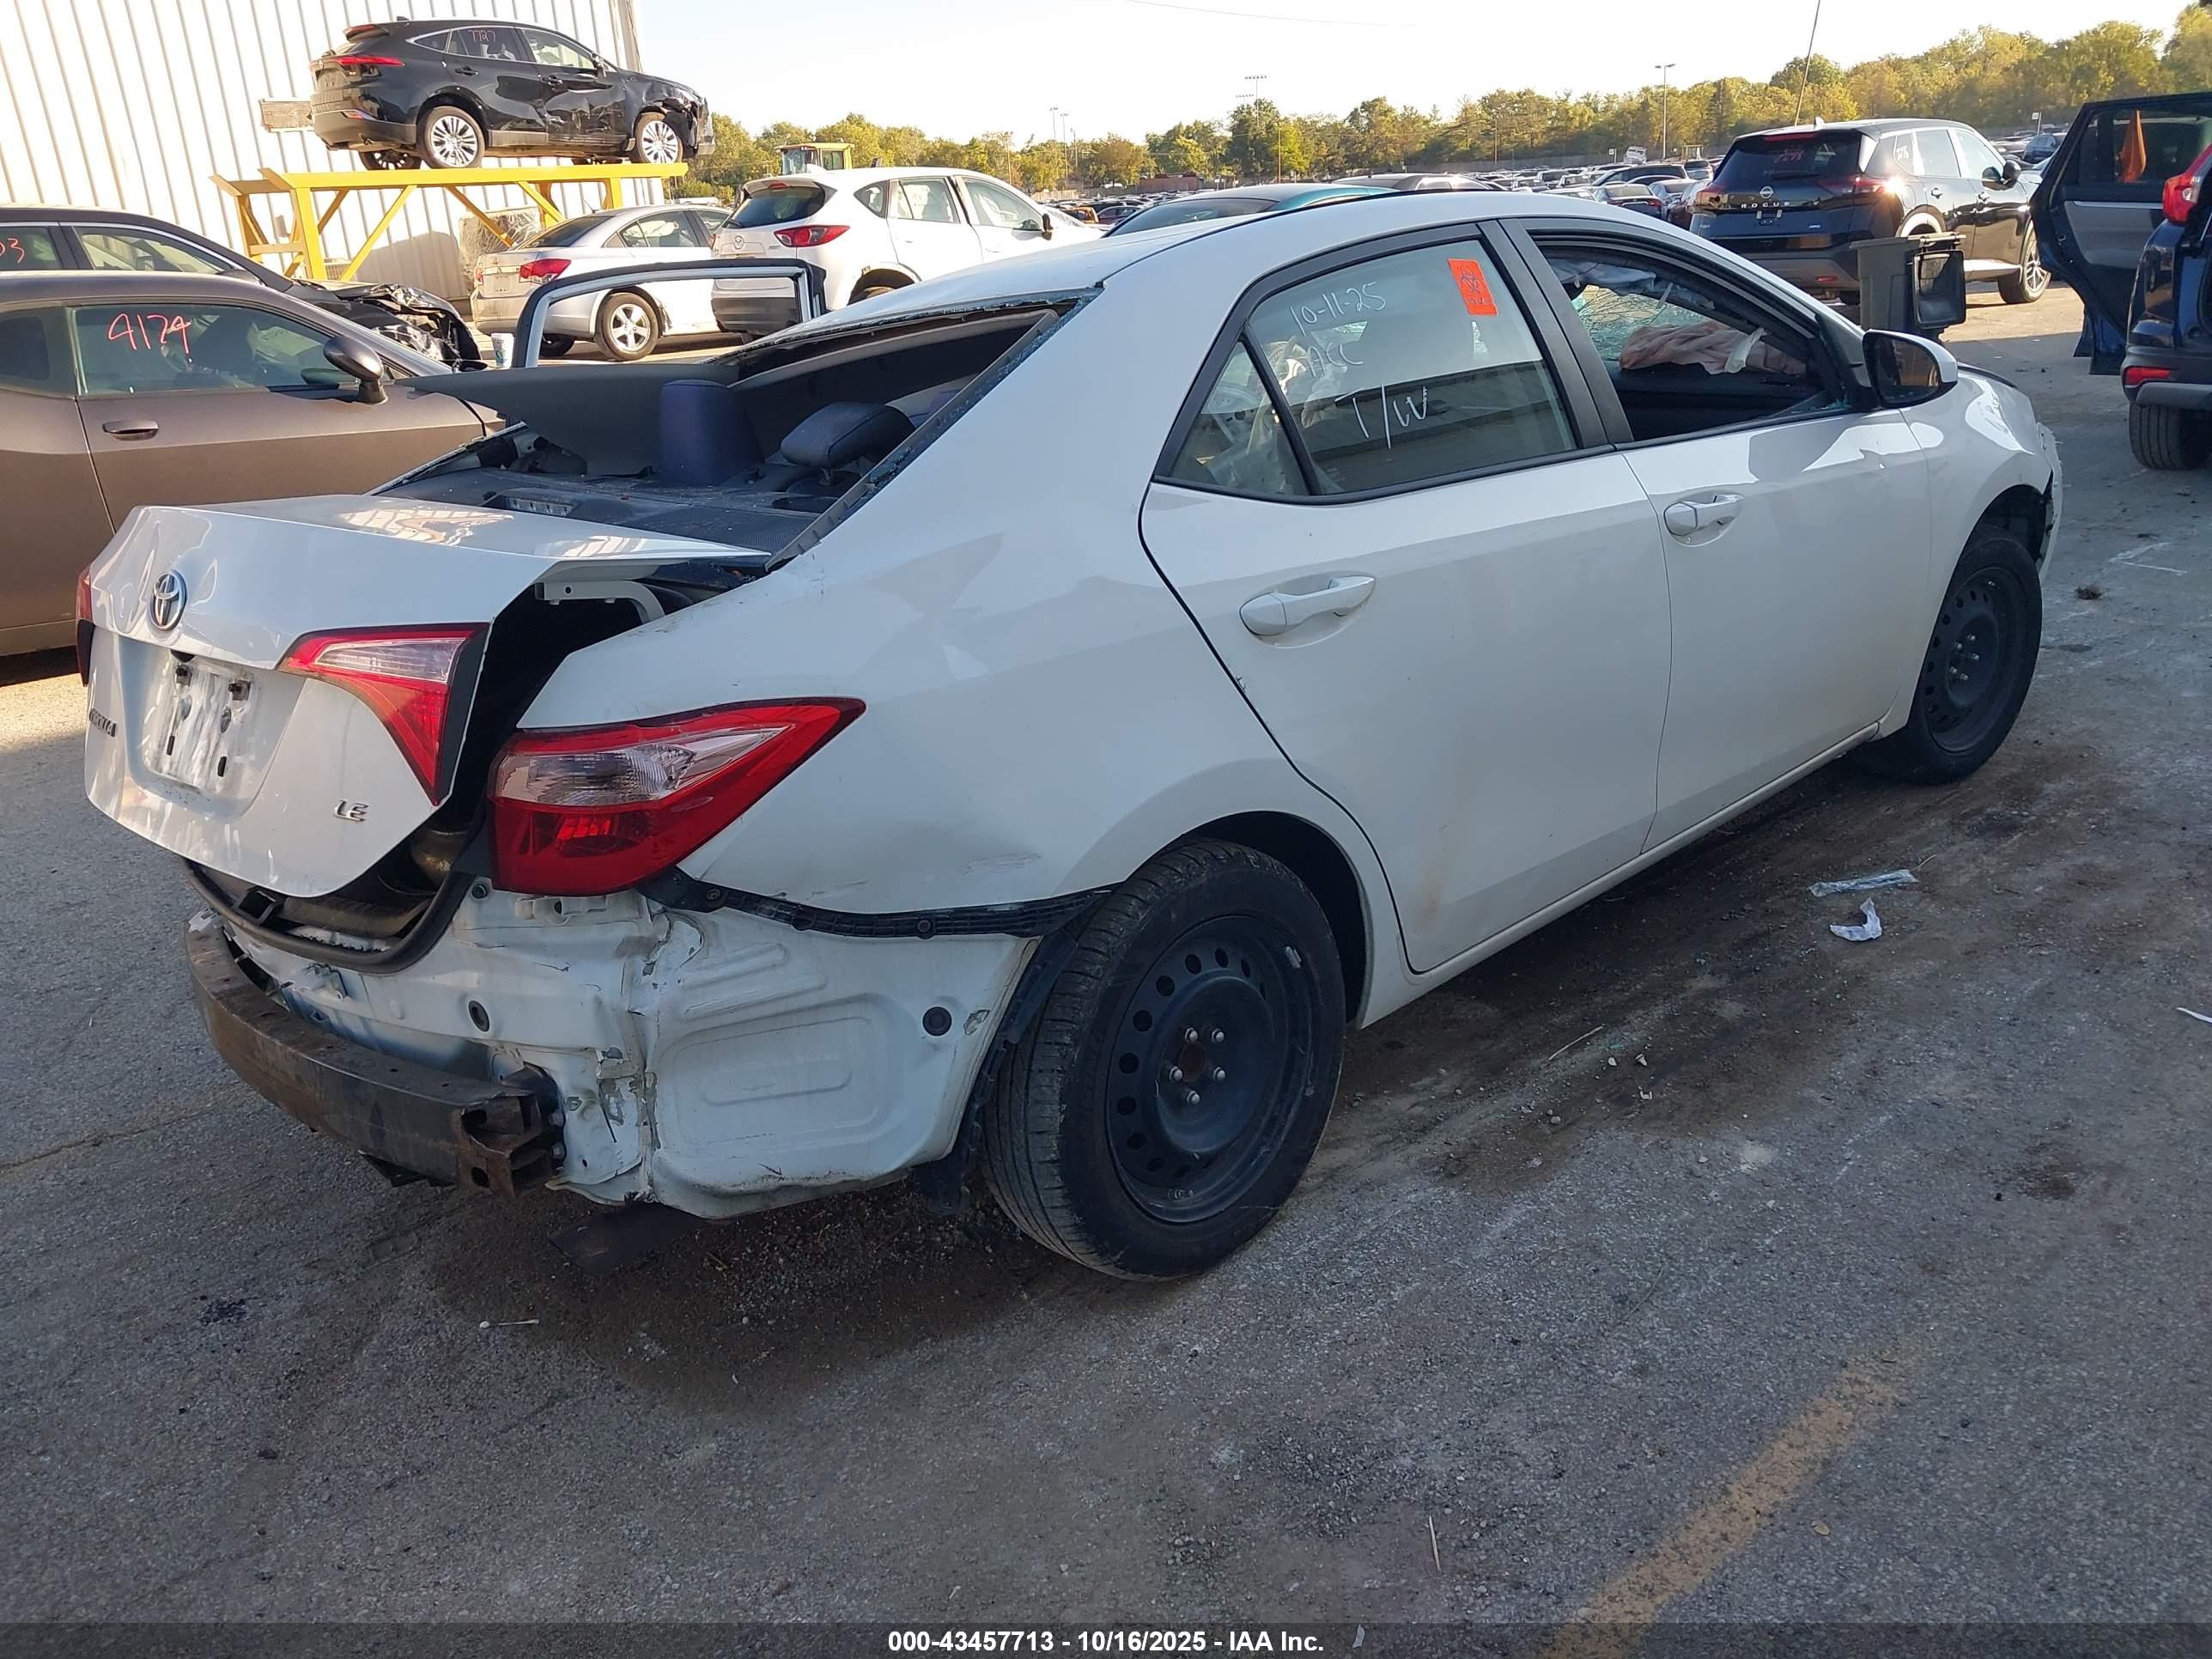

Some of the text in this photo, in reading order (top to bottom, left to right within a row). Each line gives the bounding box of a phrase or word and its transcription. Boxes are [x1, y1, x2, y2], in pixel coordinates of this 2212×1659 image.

[1740, 201, 1791, 210] ROGUE
[1290, 282, 1387, 337] 10-11-25
[334, 799, 369, 823] LE
